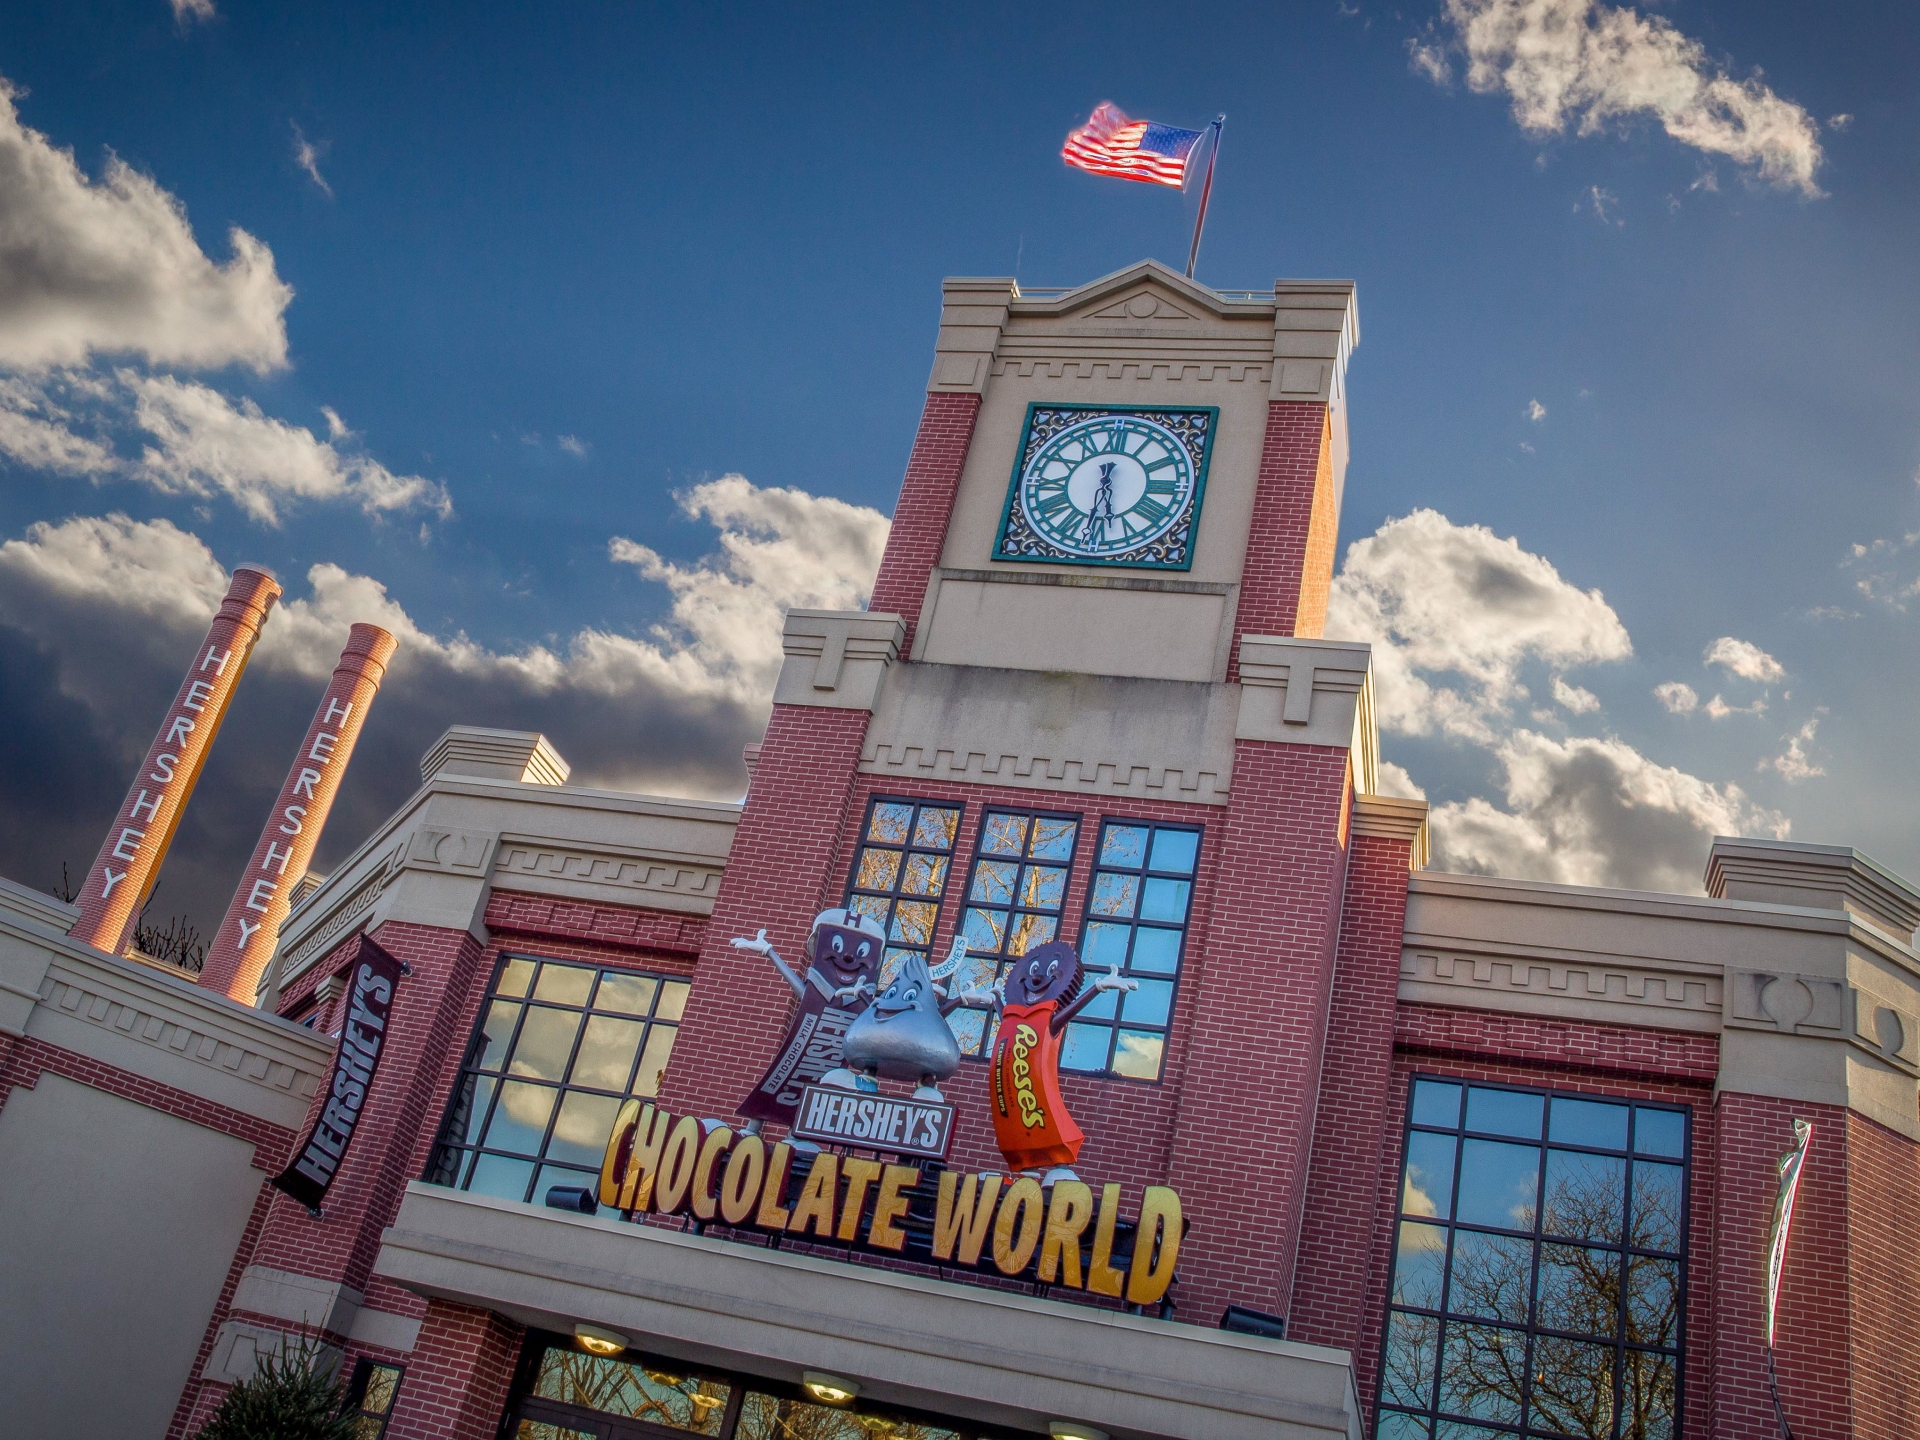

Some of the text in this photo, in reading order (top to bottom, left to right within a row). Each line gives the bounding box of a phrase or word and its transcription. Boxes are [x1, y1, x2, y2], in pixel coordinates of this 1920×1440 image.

[101, 645, 232, 899] HERSHEY
[238, 697, 353, 949] HERSHEY
[843, 910, 862, 929] H
[295, 963, 391, 1187] HERSHEY'S
[768, 1017, 814, 1090] MILK CHOCOLATE
[997, 1042, 1005, 1067] PEANUT
[805, 1092, 942, 1148] HERSHEY'S
[998, 1094, 1006, 1113] CUPS
[600, 1098, 921, 1252] CHOCOLATE
[931, 1170, 1183, 1305] WORLD
